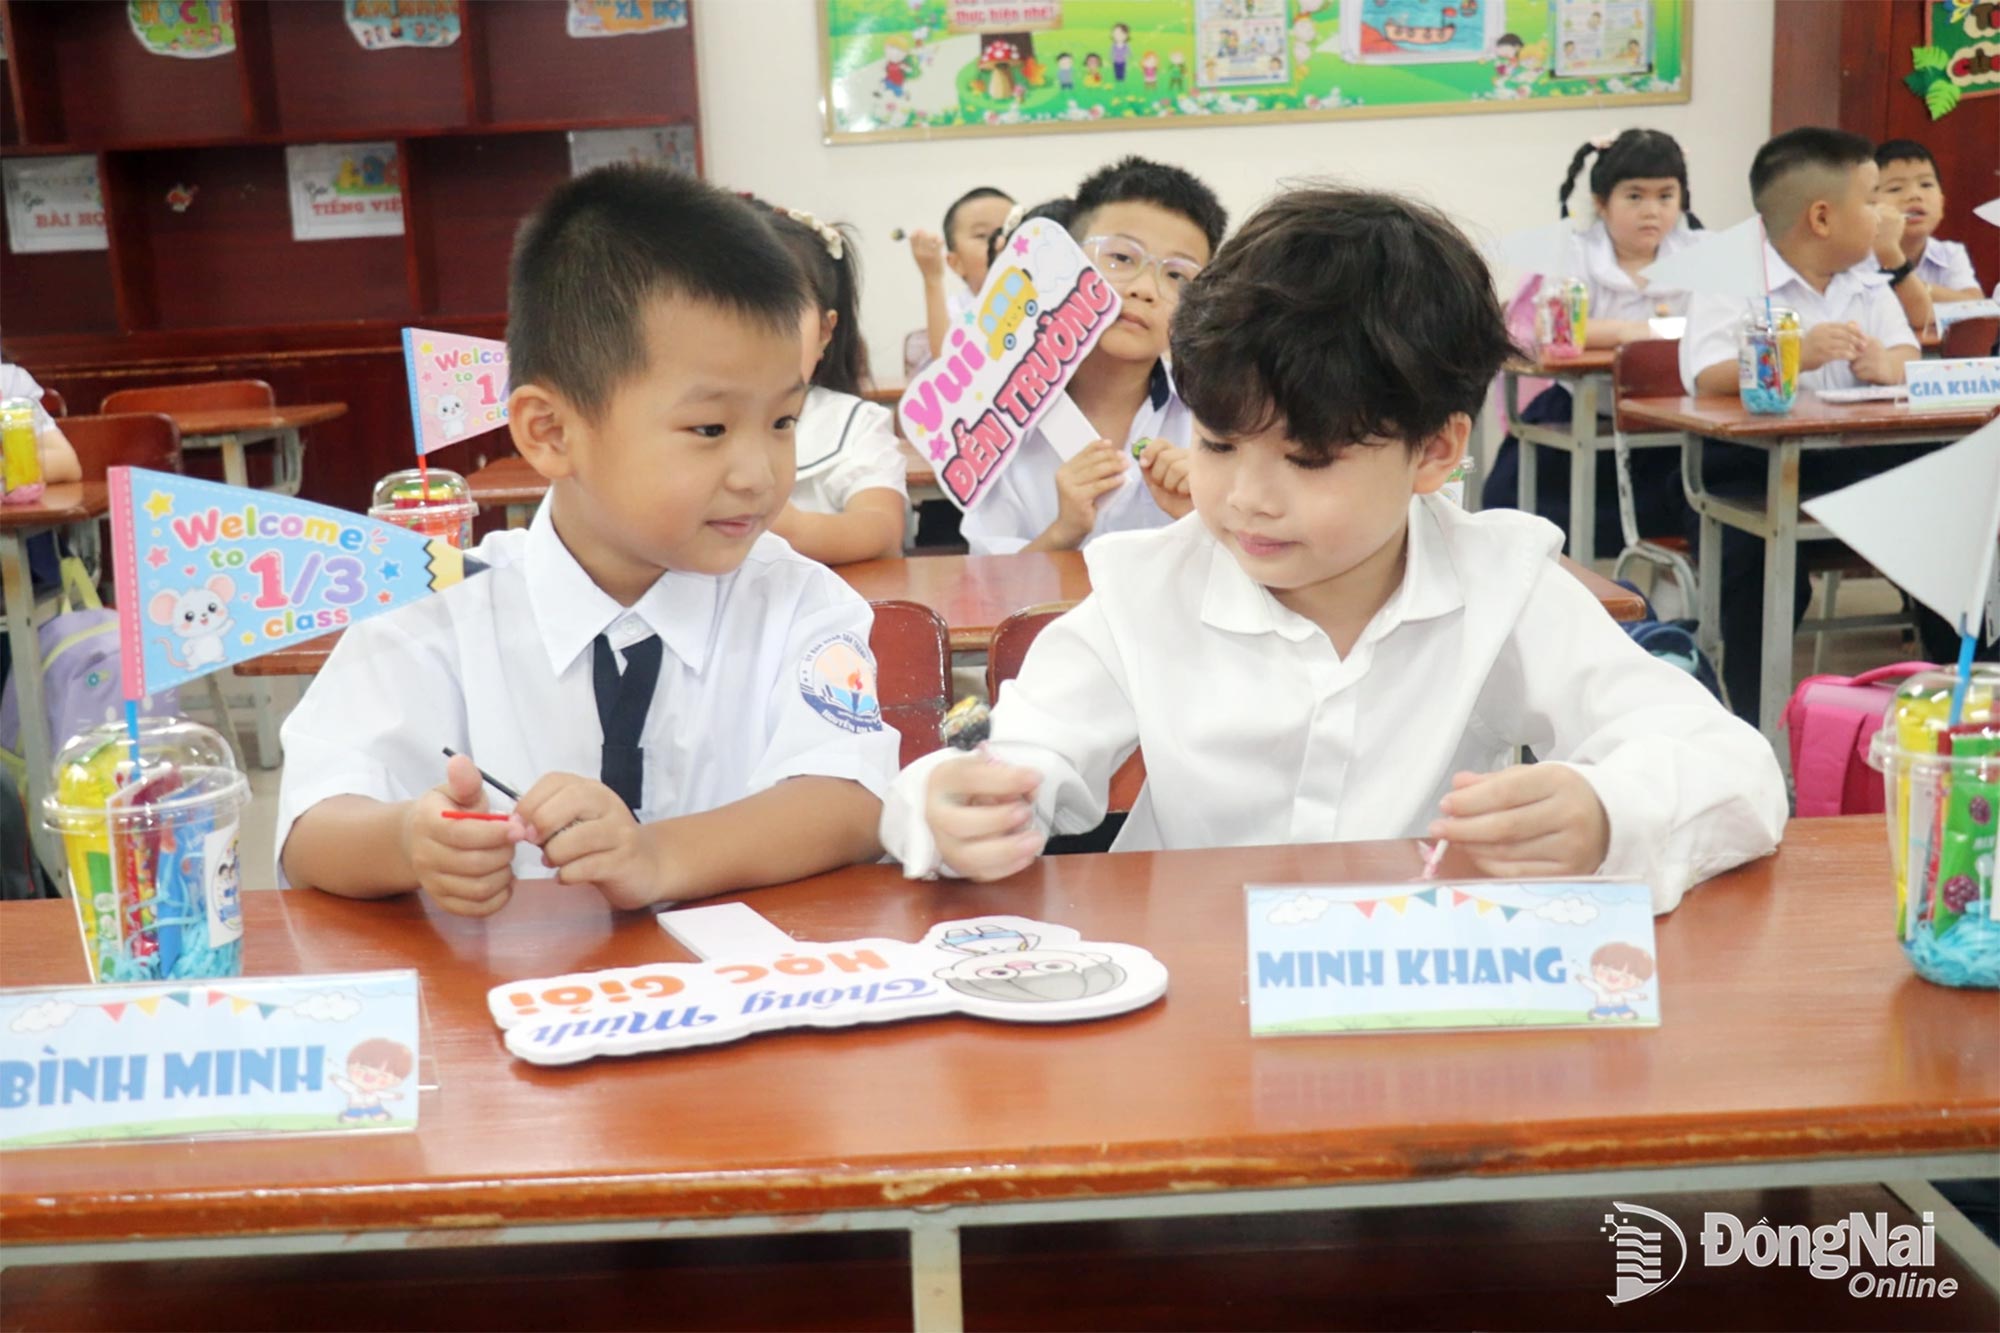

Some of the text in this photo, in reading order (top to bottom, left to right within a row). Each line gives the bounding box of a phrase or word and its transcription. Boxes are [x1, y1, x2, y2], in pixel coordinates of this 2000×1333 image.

[455, 372, 473, 382] to
[903, 328, 985, 432] Vui
[943, 266, 1114, 505] ĐẾN TRƯỜNG
[1909, 381, 1944, 397] GIA
[172, 505, 364, 550] Welcome
[210, 549, 366, 609] to 1/3
[264, 608, 350, 638] class
[1257, 946, 1568, 988] MINH KHANG
[532, 977, 938, 1047] Thông Minh
[0, 1045, 325, 1109] BÌNH MINH
